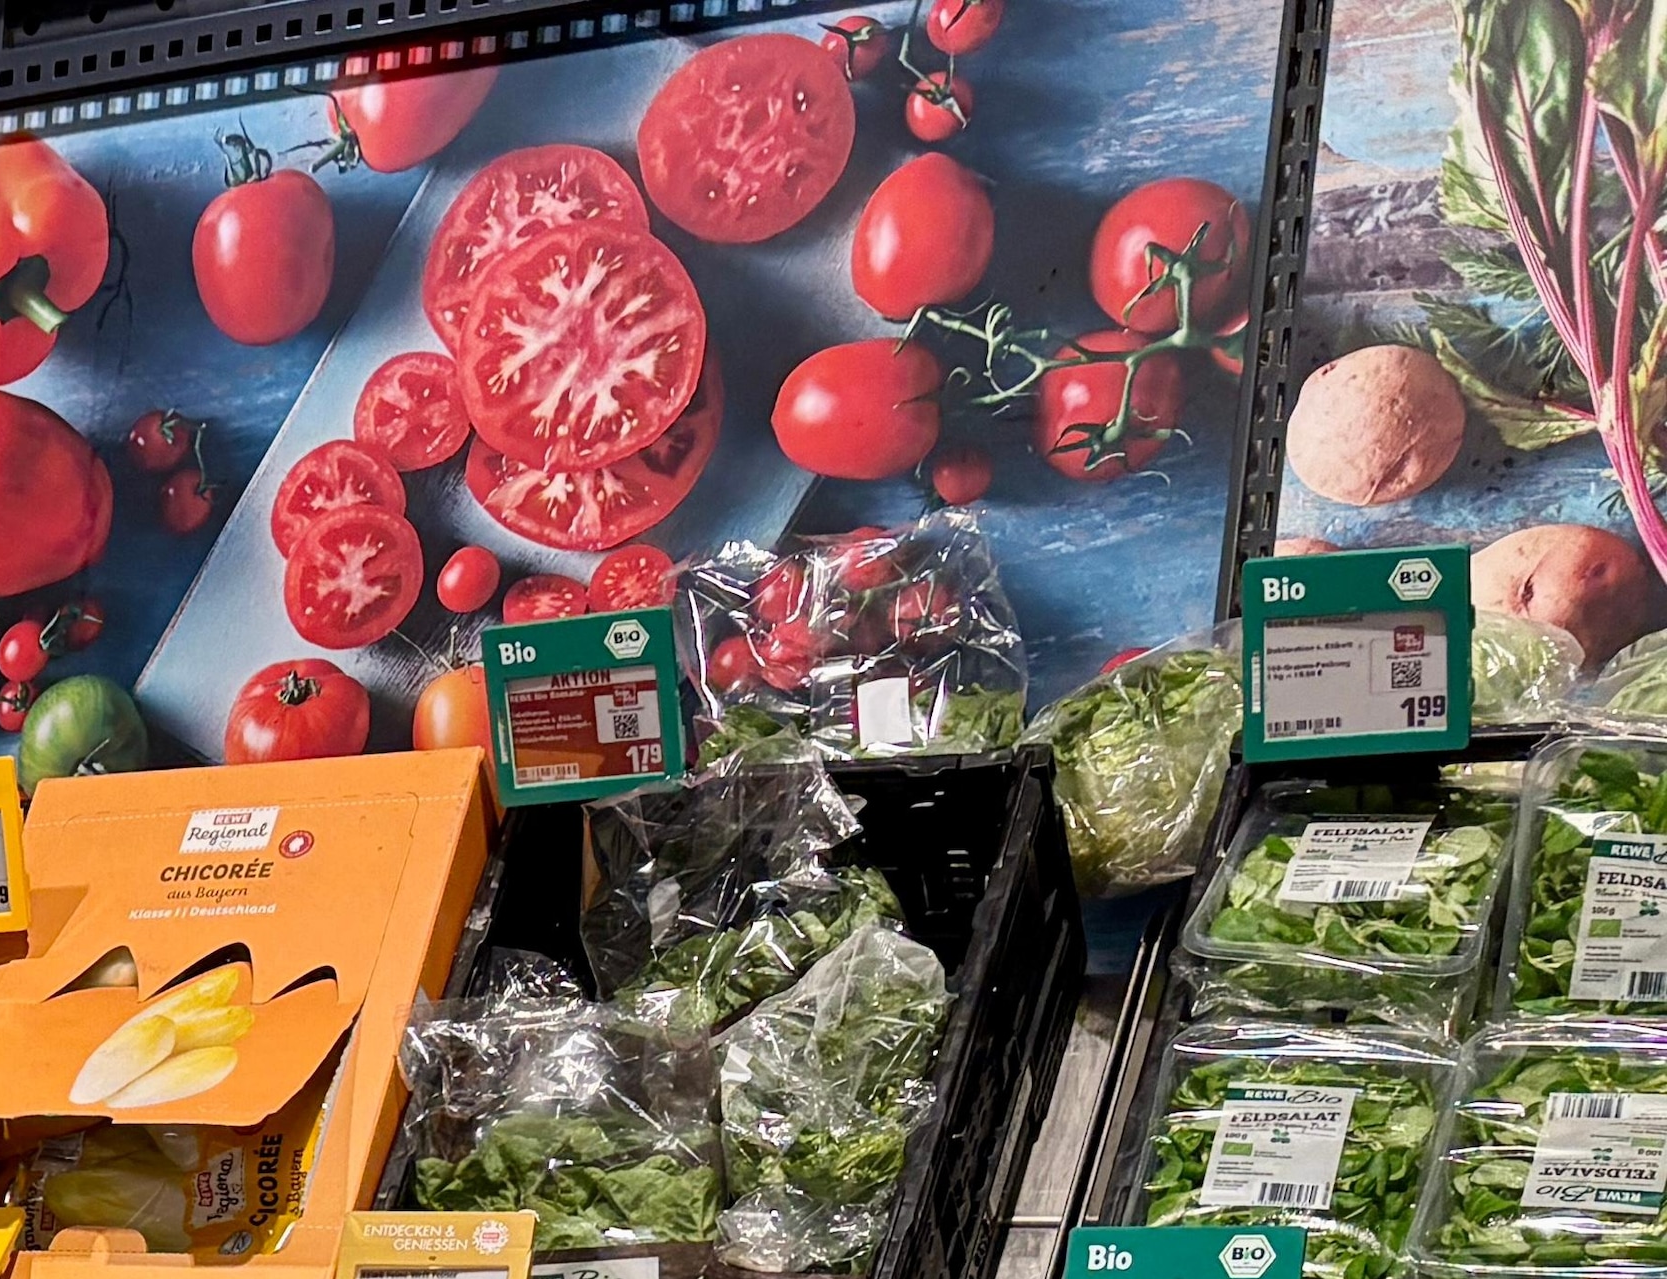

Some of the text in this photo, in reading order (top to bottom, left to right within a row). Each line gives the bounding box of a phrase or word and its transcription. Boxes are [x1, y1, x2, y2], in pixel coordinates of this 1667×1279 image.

[1262, 576, 1306, 602] Bio
[498, 641, 537, 665] Bio
[551, 669, 612, 688] AKTION
[1400, 694, 1446, 727] 1.99
[626, 743, 663, 773] 1.79
[187, 822, 268, 846] Regional
[1610, 844, 1651, 860] REWE
[160, 858, 275, 882] CHICORÉE
[166, 886, 249, 904] aus Bayern
[127, 904, 278, 920] Klasse Deutschland
[1244, 1088, 1343, 1106] REWE Bio
[1231, 1111, 1341, 1124] FELDSALAT
[1539, 1166, 1658, 1180] FELDSALAT
[1536, 1184, 1642, 1204] REWE Bio
[363, 1224, 456, 1239] ENTDECKEN &
[394, 1238, 469, 1251] GENIESSEN
[1087, 1244, 1134, 1271] Bio
